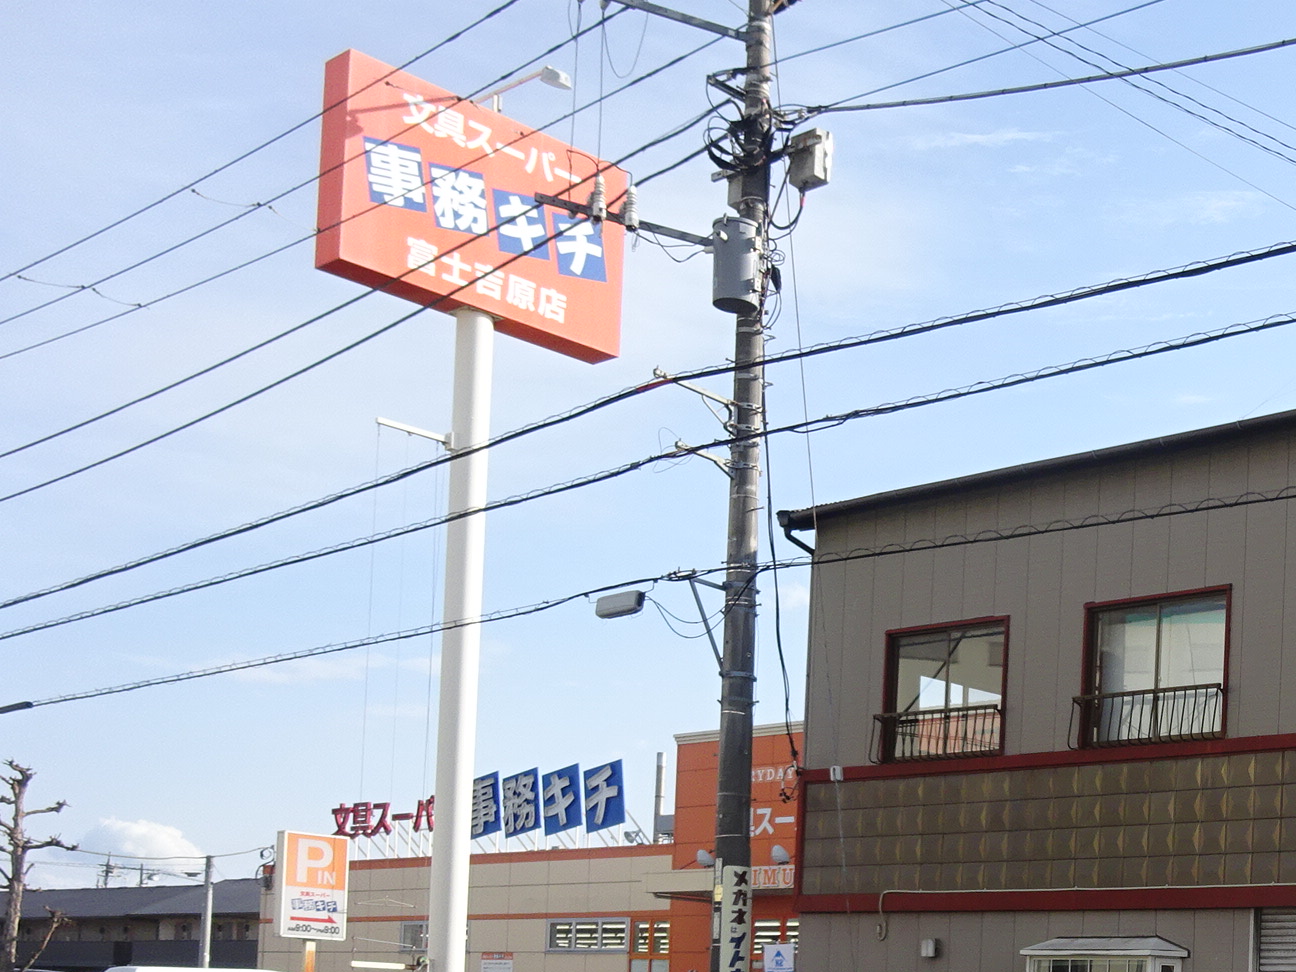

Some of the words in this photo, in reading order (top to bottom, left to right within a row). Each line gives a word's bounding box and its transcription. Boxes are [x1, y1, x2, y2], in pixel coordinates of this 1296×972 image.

[402, 92, 582, 184] 文具スーパー
[363, 140, 605, 277] 事務キチ
[406, 237, 568, 324] 富士吉原店
[471, 765, 619, 835] 事務キチ
[296, 838, 333, 883] P
[317, 871, 336, 885] IN
